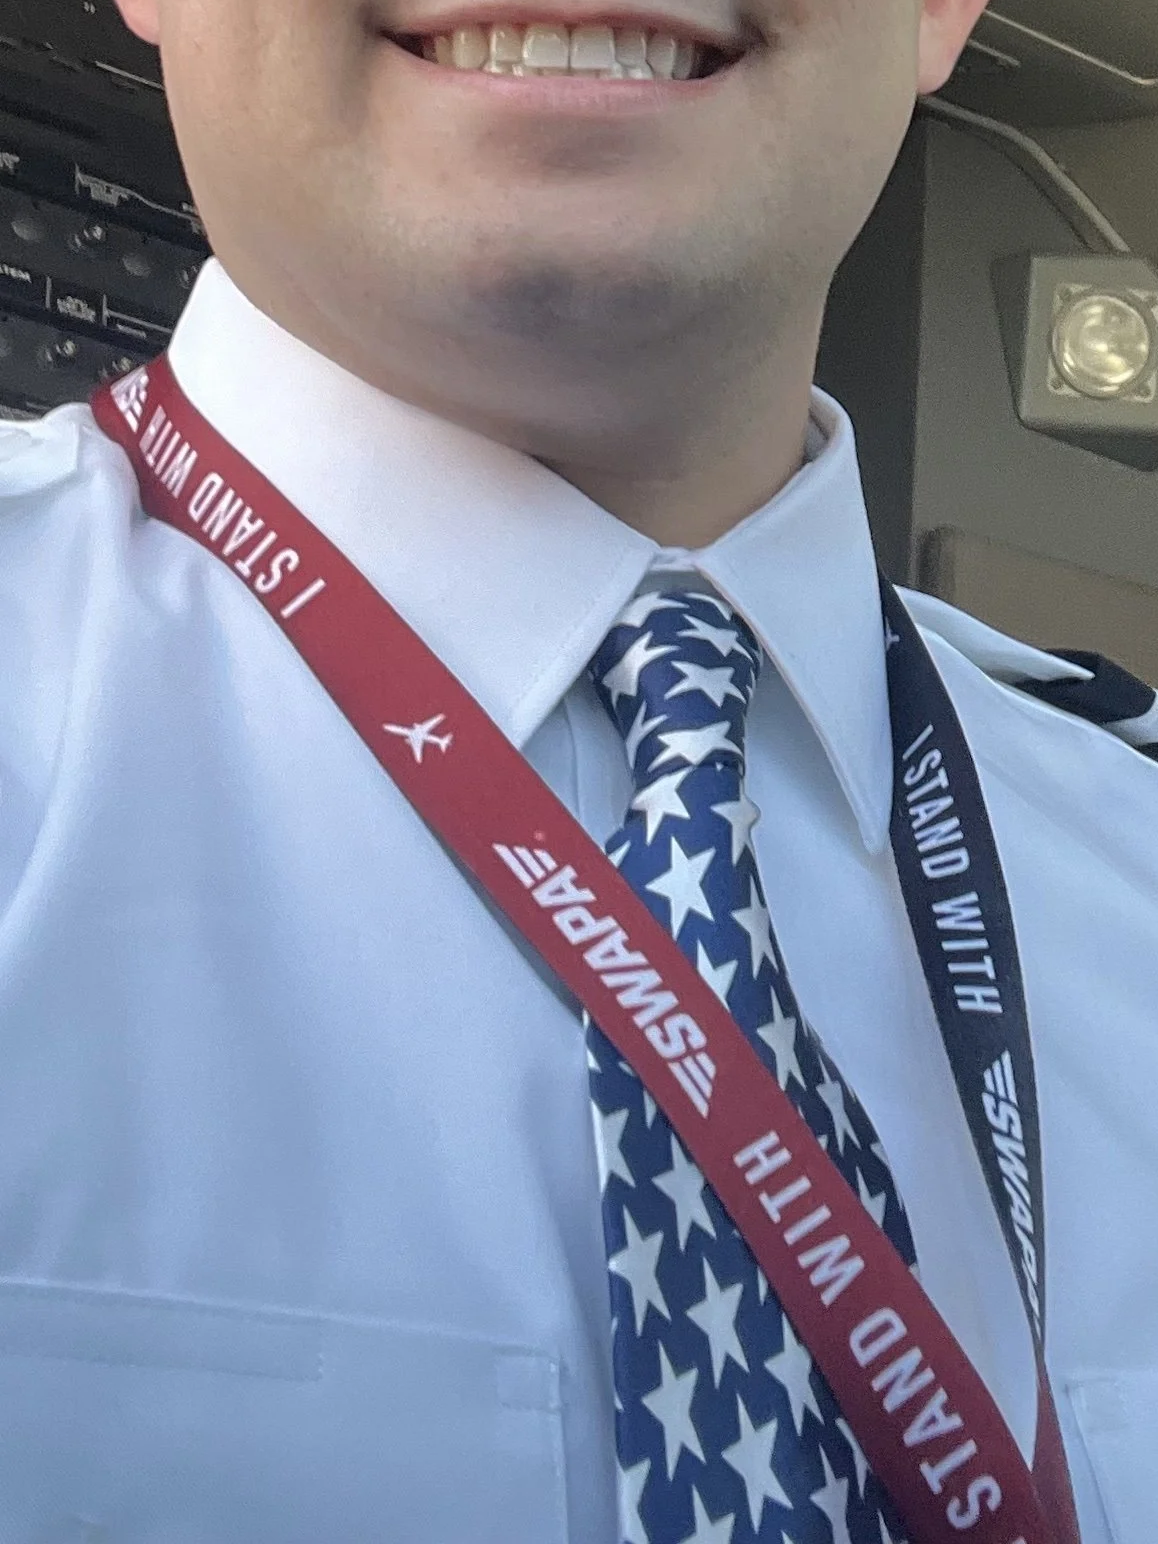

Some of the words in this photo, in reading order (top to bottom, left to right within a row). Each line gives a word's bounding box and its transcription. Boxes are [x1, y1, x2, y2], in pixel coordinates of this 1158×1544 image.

[139, 404, 198, 499] WITH
[187, 471, 300, 594] STAND
[280, 577, 326, 619] I
[902, 724, 934, 760] I
[903, 748, 971, 879] STAND
[529, 861, 709, 1062] SWAPA
[931, 891, 1004, 1014] WITH
[732, 1130, 866, 1307] WITH
[849, 1306, 1003, 1530] STAND
